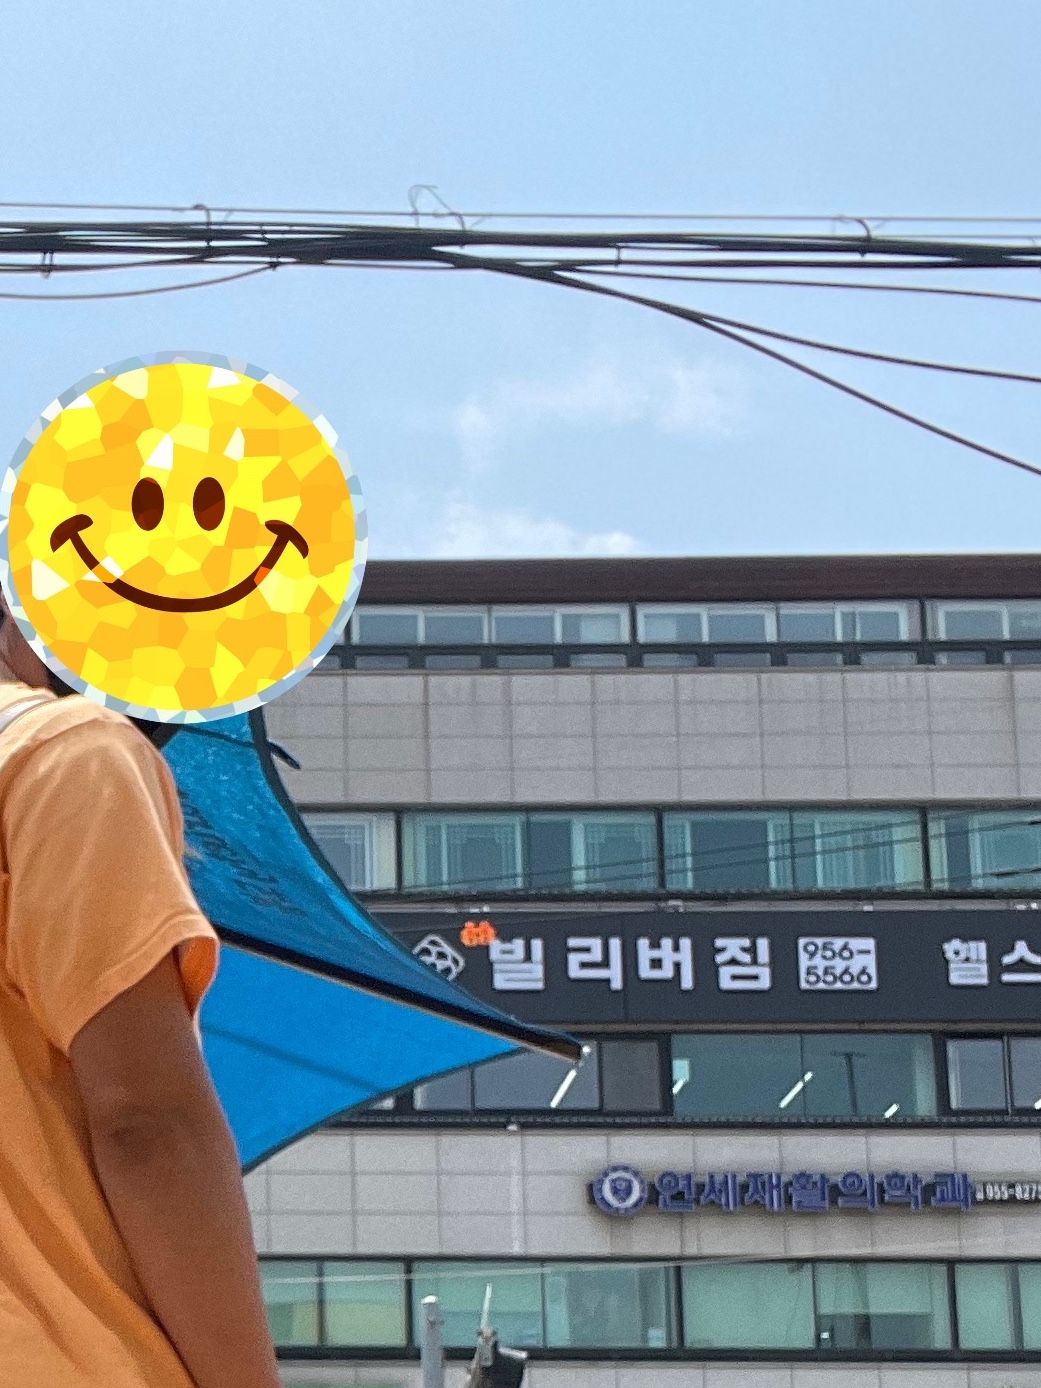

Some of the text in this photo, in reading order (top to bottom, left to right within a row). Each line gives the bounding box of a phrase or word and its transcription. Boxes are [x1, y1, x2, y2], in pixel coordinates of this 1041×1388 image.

[489, 937, 771, 991] 빌리버짐
[803, 940, 872, 961] 956-
[804, 966, 873, 986] 5566
[655, 1170, 972, 1212] 연세재활의학과
